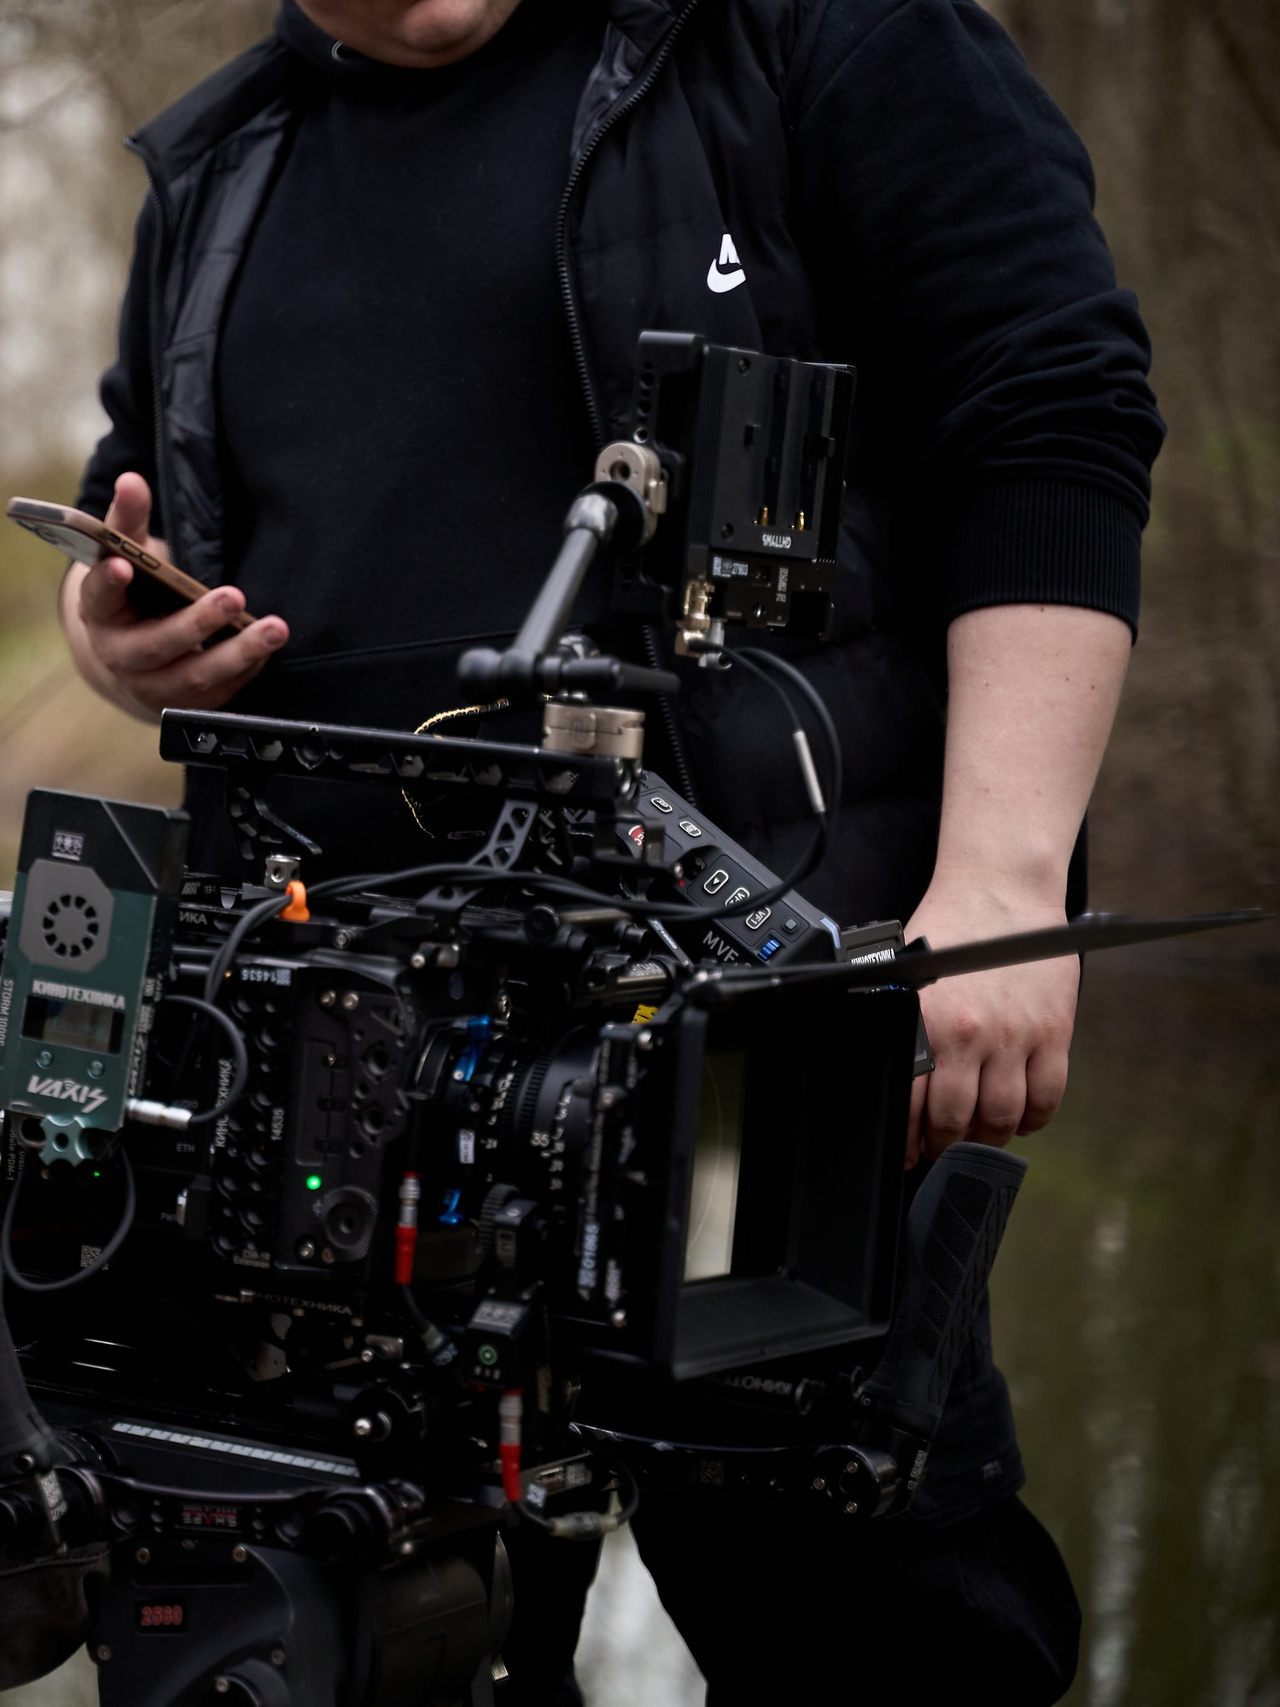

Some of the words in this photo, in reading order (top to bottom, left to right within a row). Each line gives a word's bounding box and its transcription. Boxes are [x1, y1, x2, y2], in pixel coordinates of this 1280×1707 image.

[752, 909, 767, 925] VF1
[0, 979, 14, 1013] STORM
[32, 979, 126, 1010] КИНОТЕХНИКА
[26, 1075, 109, 1114] VAXIS
[214, 1058, 233, 1148] КИНОХНИКА
[270, 1107, 285, 1141] 14535
[530, 1130, 550, 1148] 35
[253, 1291, 353, 1316] ИНОТЕХНИКА
[182, 1511, 237, 1527] SHAPE
